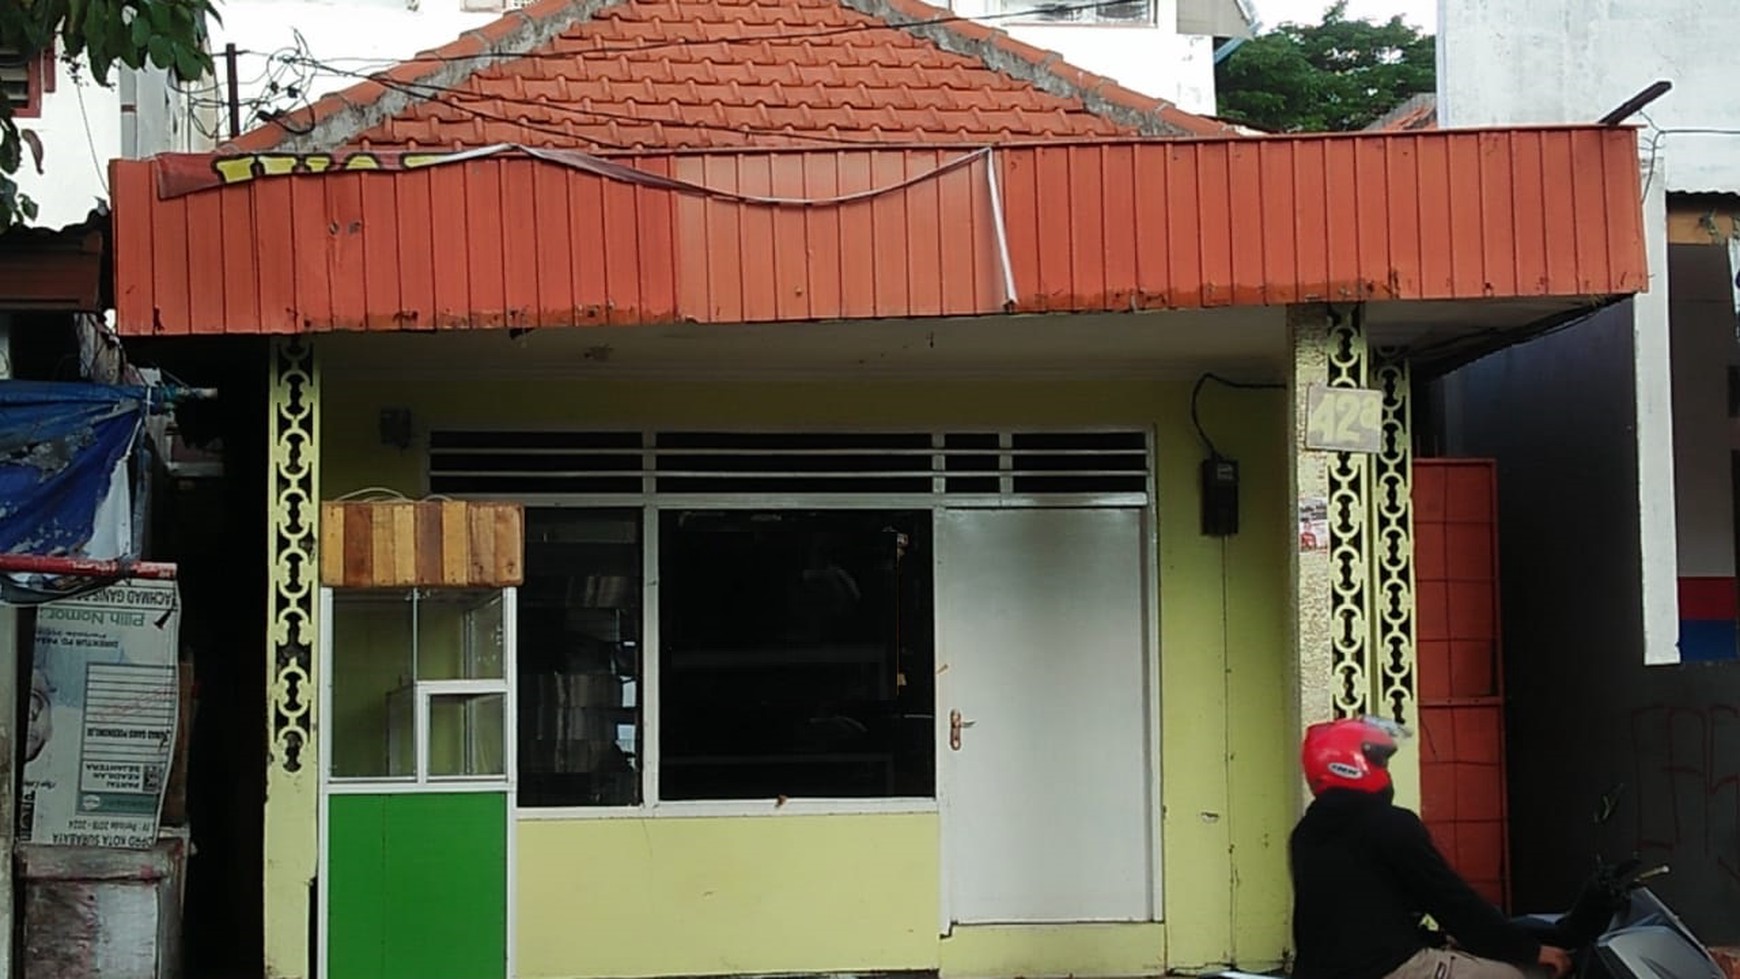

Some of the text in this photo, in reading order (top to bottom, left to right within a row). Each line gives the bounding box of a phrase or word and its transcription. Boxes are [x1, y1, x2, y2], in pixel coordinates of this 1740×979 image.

[50, 608, 104, 624] Nomor
[111, 612, 145, 627] Pilih
[106, 780, 140, 789] PARTAI
[52, 832, 99, 847] SURABAYA
[102, 834, 126, 847] KOTA
